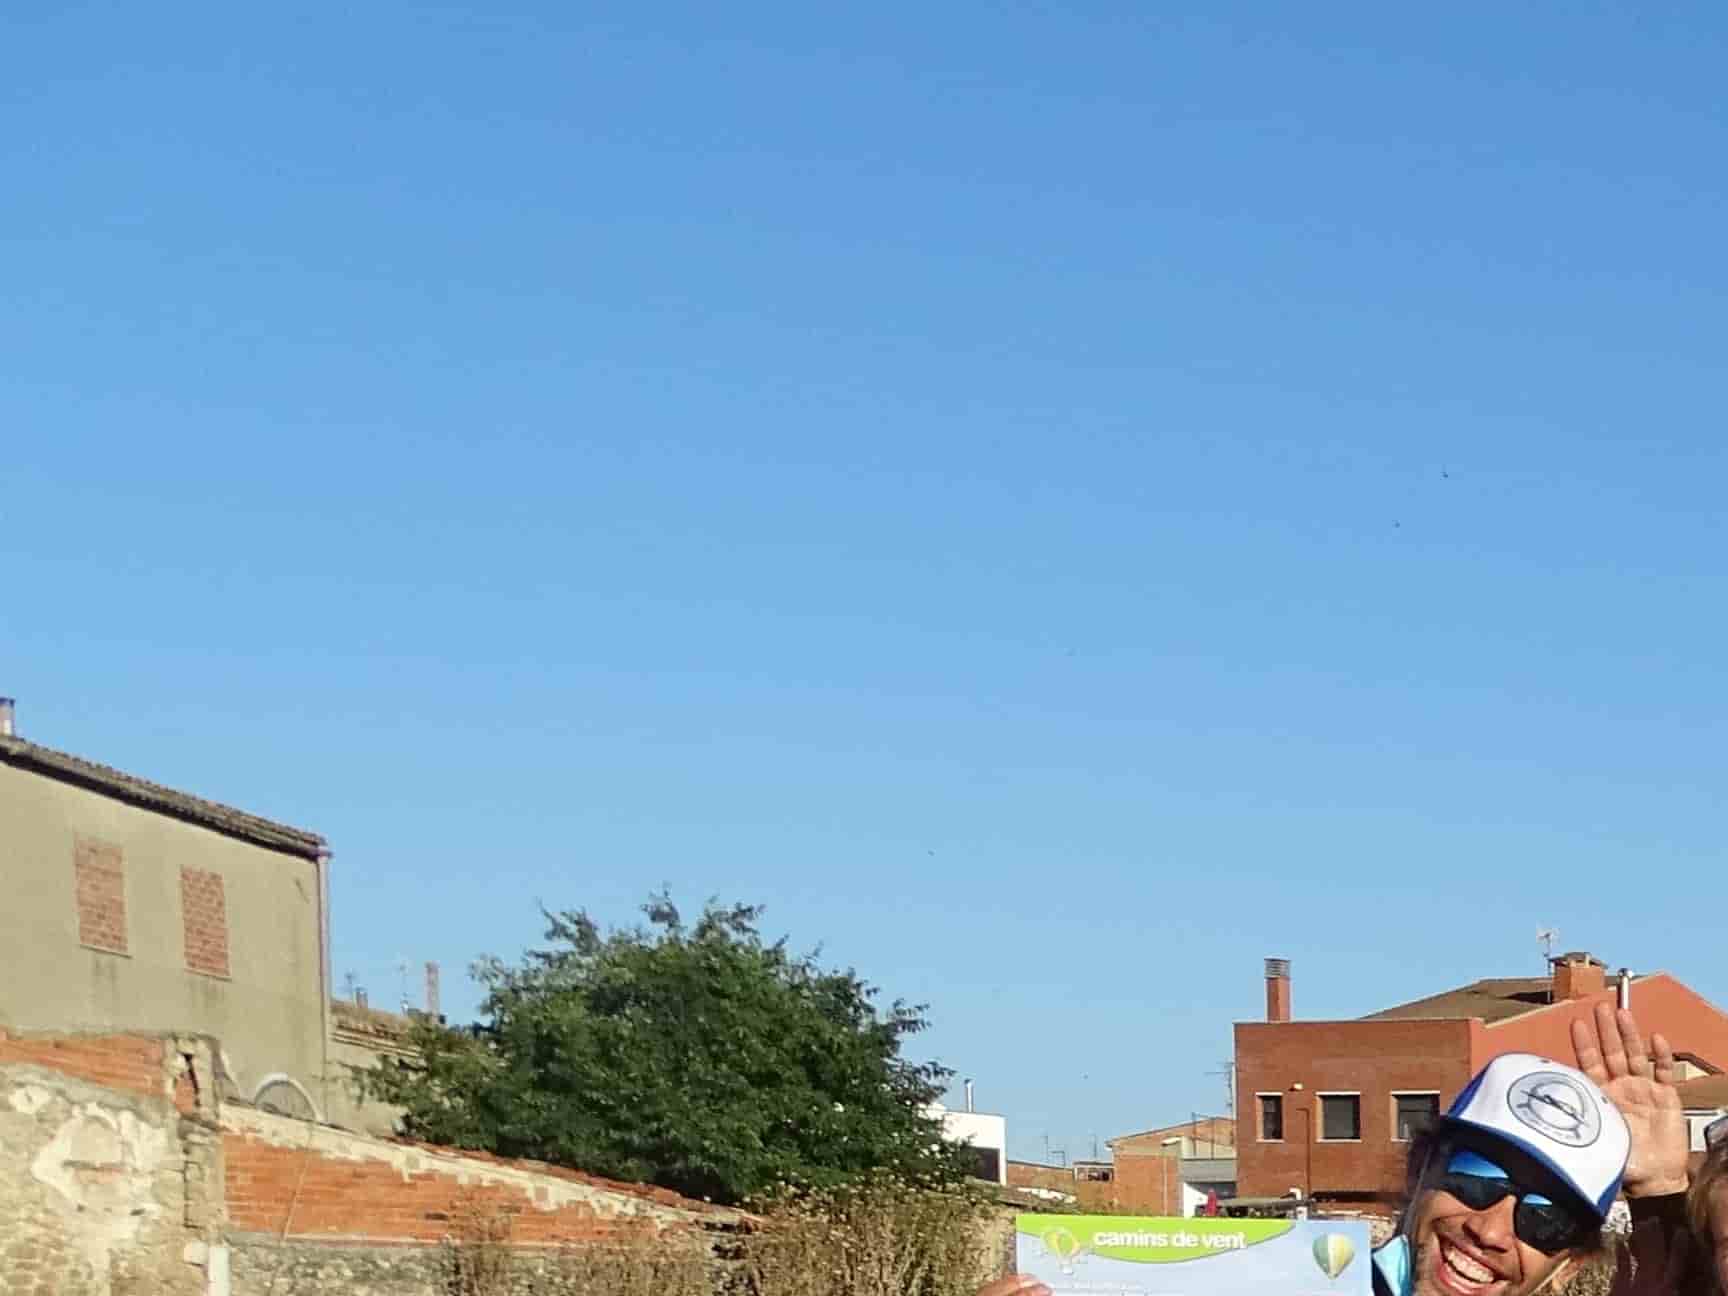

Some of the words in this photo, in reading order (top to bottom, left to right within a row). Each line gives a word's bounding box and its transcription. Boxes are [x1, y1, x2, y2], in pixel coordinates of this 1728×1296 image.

[1093, 1229, 1166, 1249] camins
[1171, 1230, 1198, 1249] de
[1201, 1231, 1247, 1251] vent
